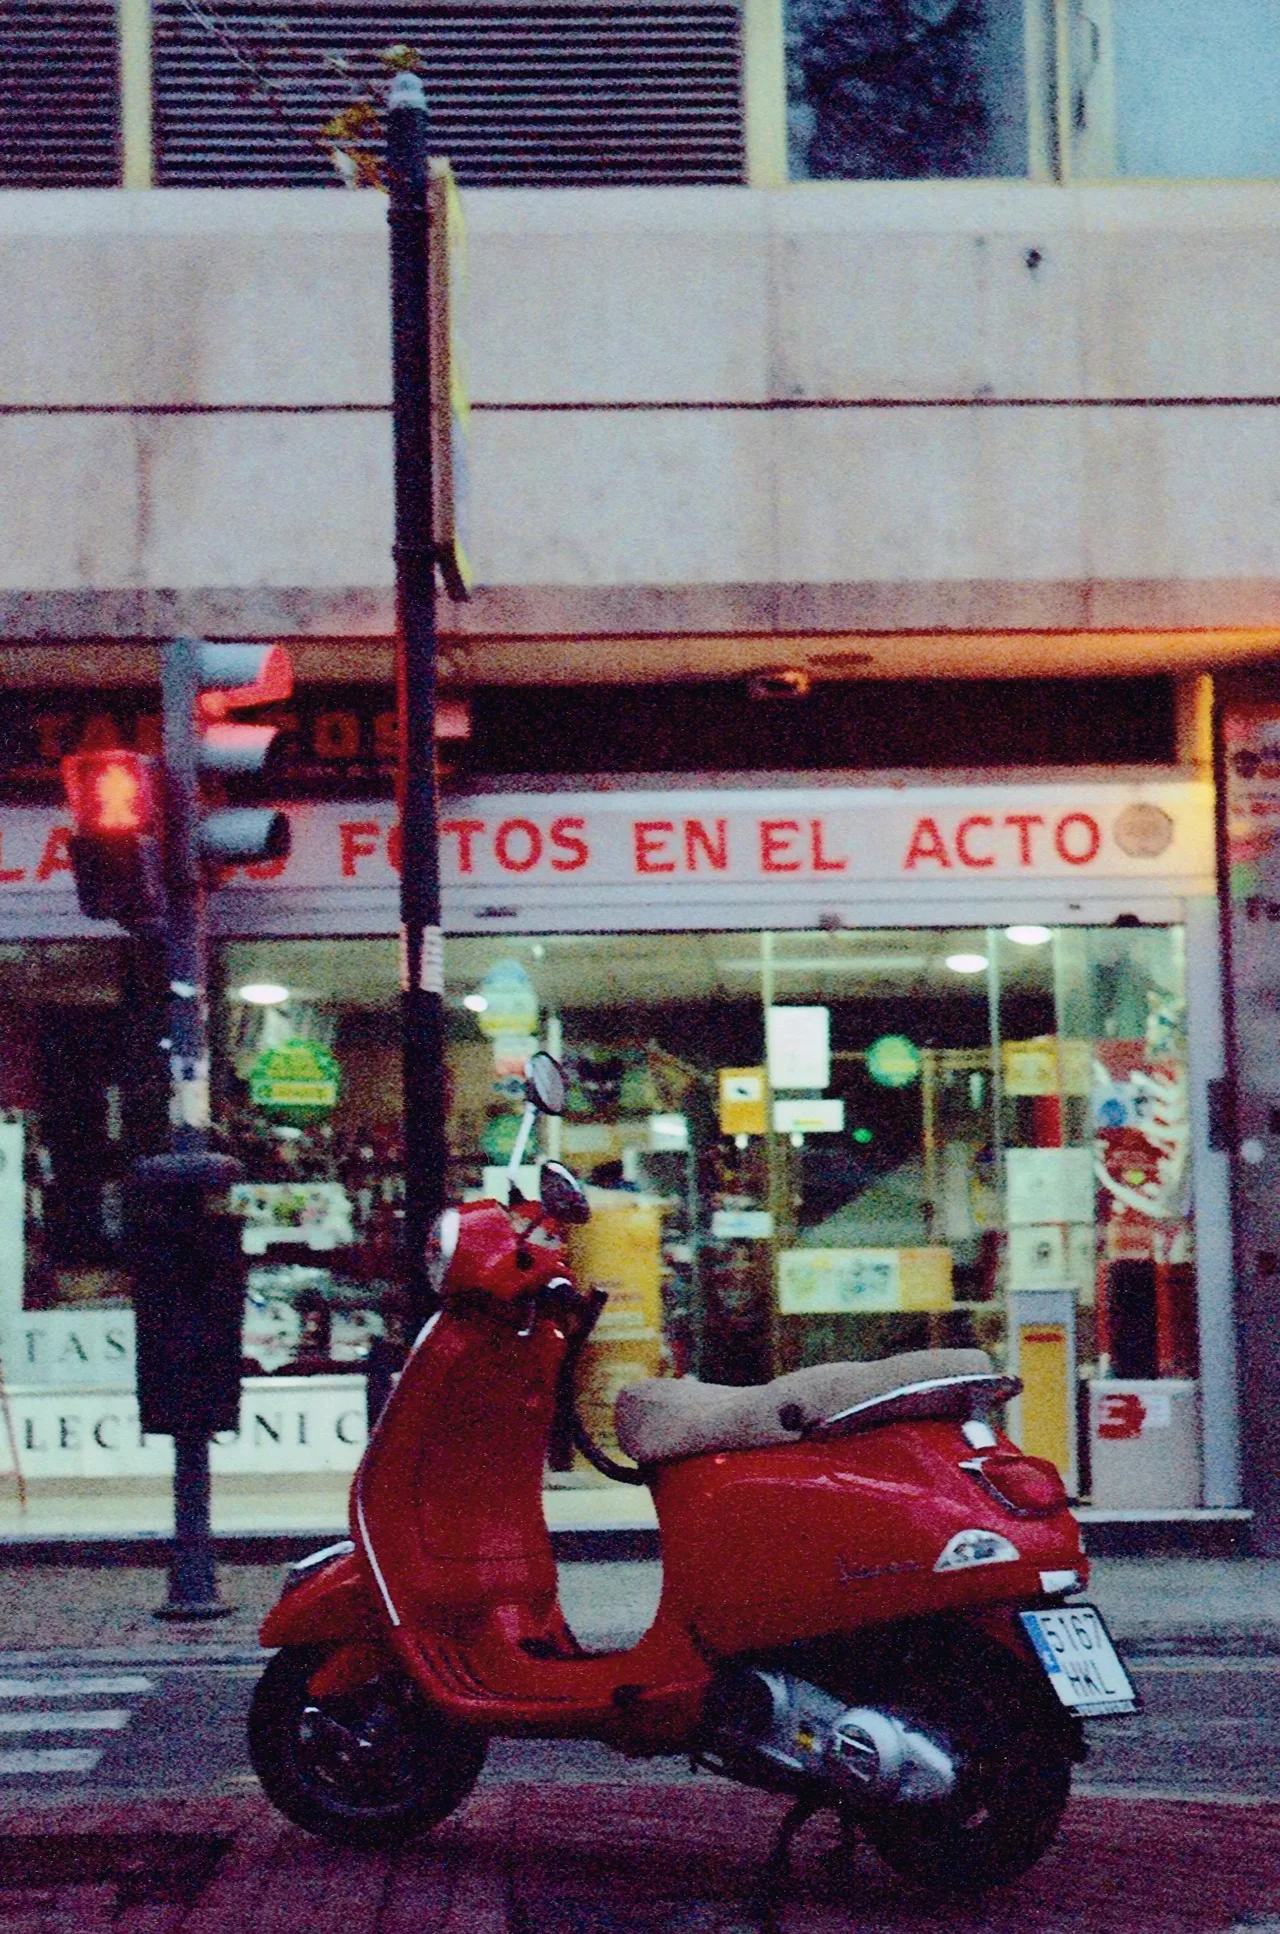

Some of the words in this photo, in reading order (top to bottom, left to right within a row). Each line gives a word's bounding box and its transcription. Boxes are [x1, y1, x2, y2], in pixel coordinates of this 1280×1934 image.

[339, 818, 590, 878] FTOS
[633, 819, 729, 873] EN
[759, 818, 849, 871] EL
[904, 812, 1102, 869] ACTO
[1040, 1613, 1102, 1653] 5167
